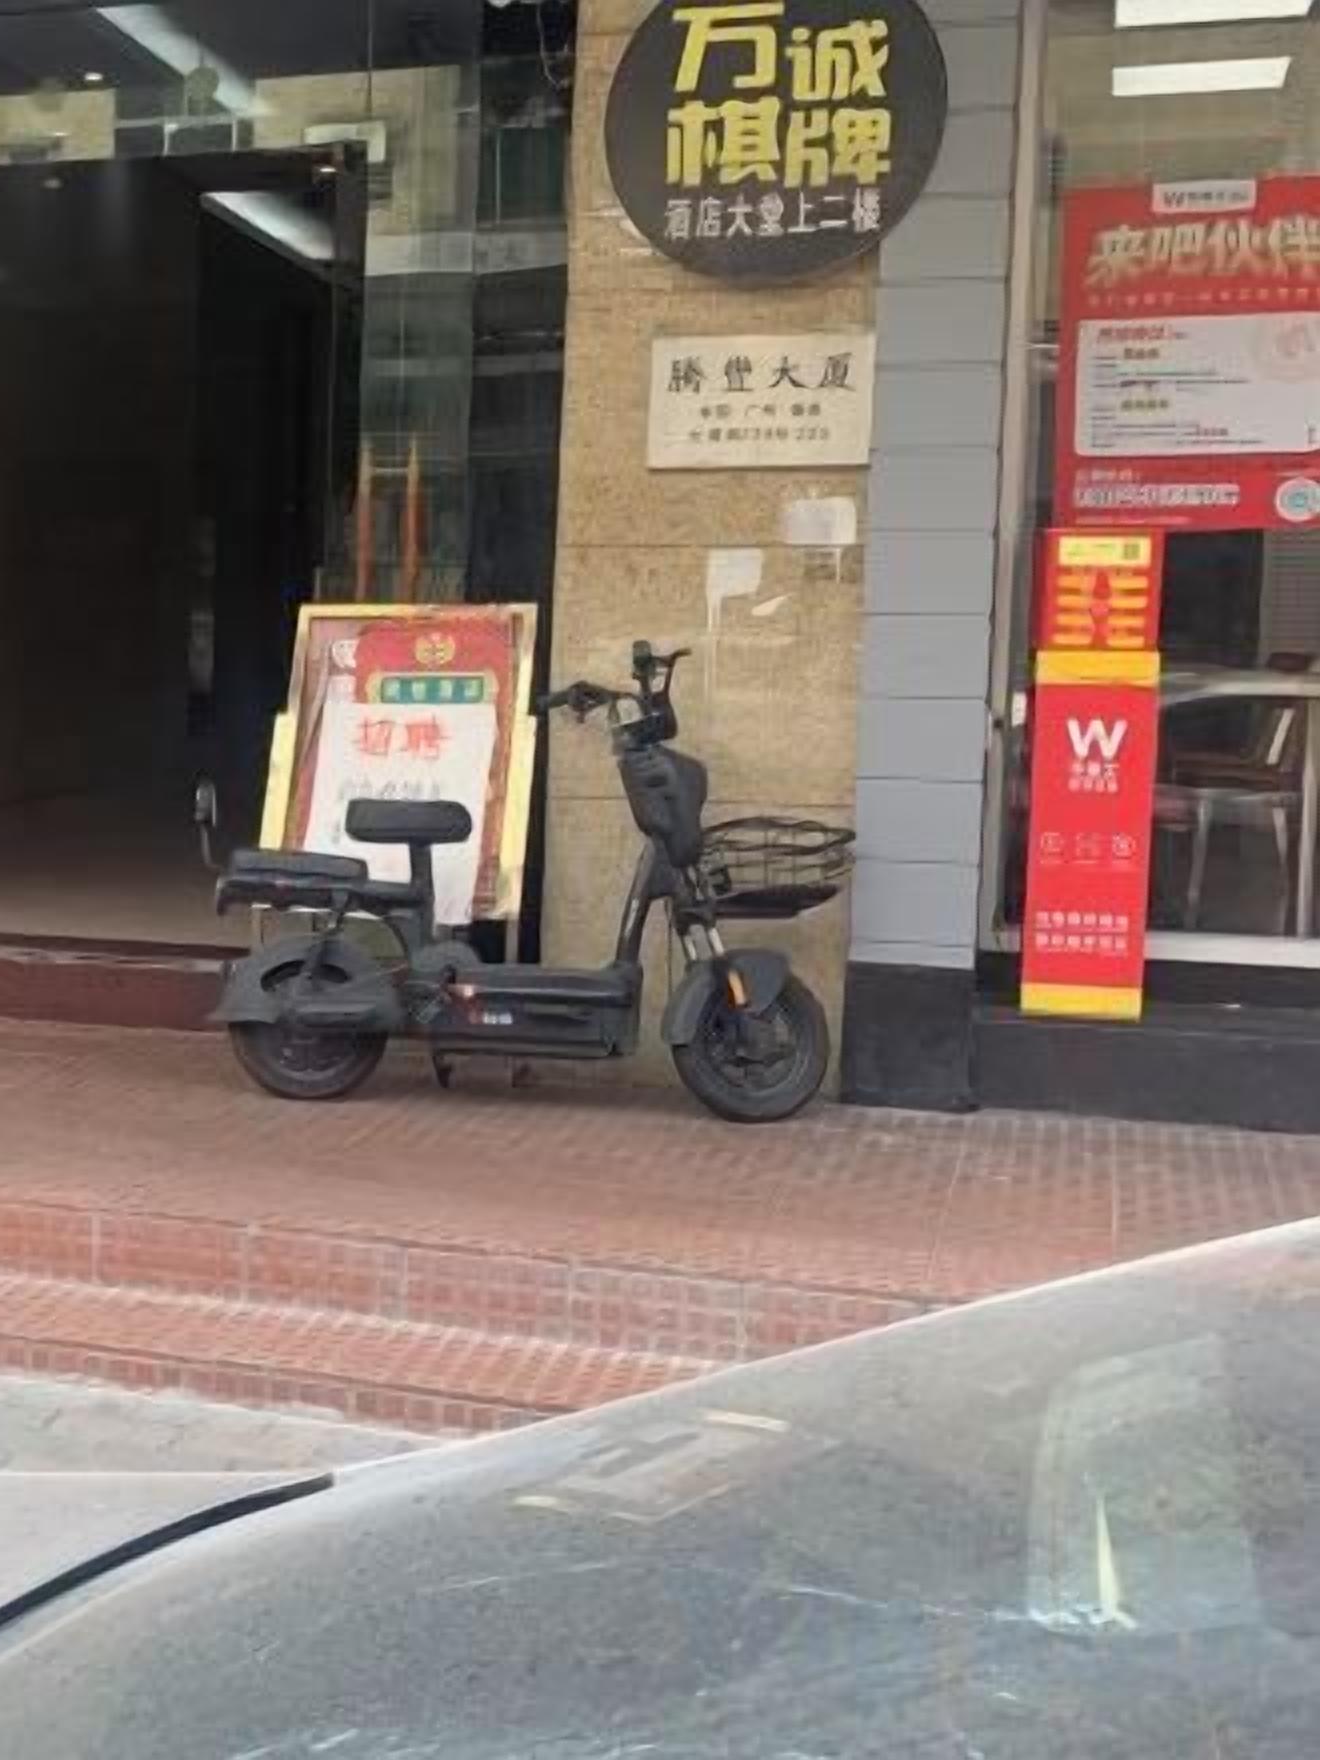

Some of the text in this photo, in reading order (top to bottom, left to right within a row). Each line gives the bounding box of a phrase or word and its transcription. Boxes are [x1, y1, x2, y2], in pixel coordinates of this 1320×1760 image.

[673, 3, 889, 101] 万诚
[665, 97, 892, 188] 棋牌
[664, 189, 881, 240] 酒店大堂上二楼
